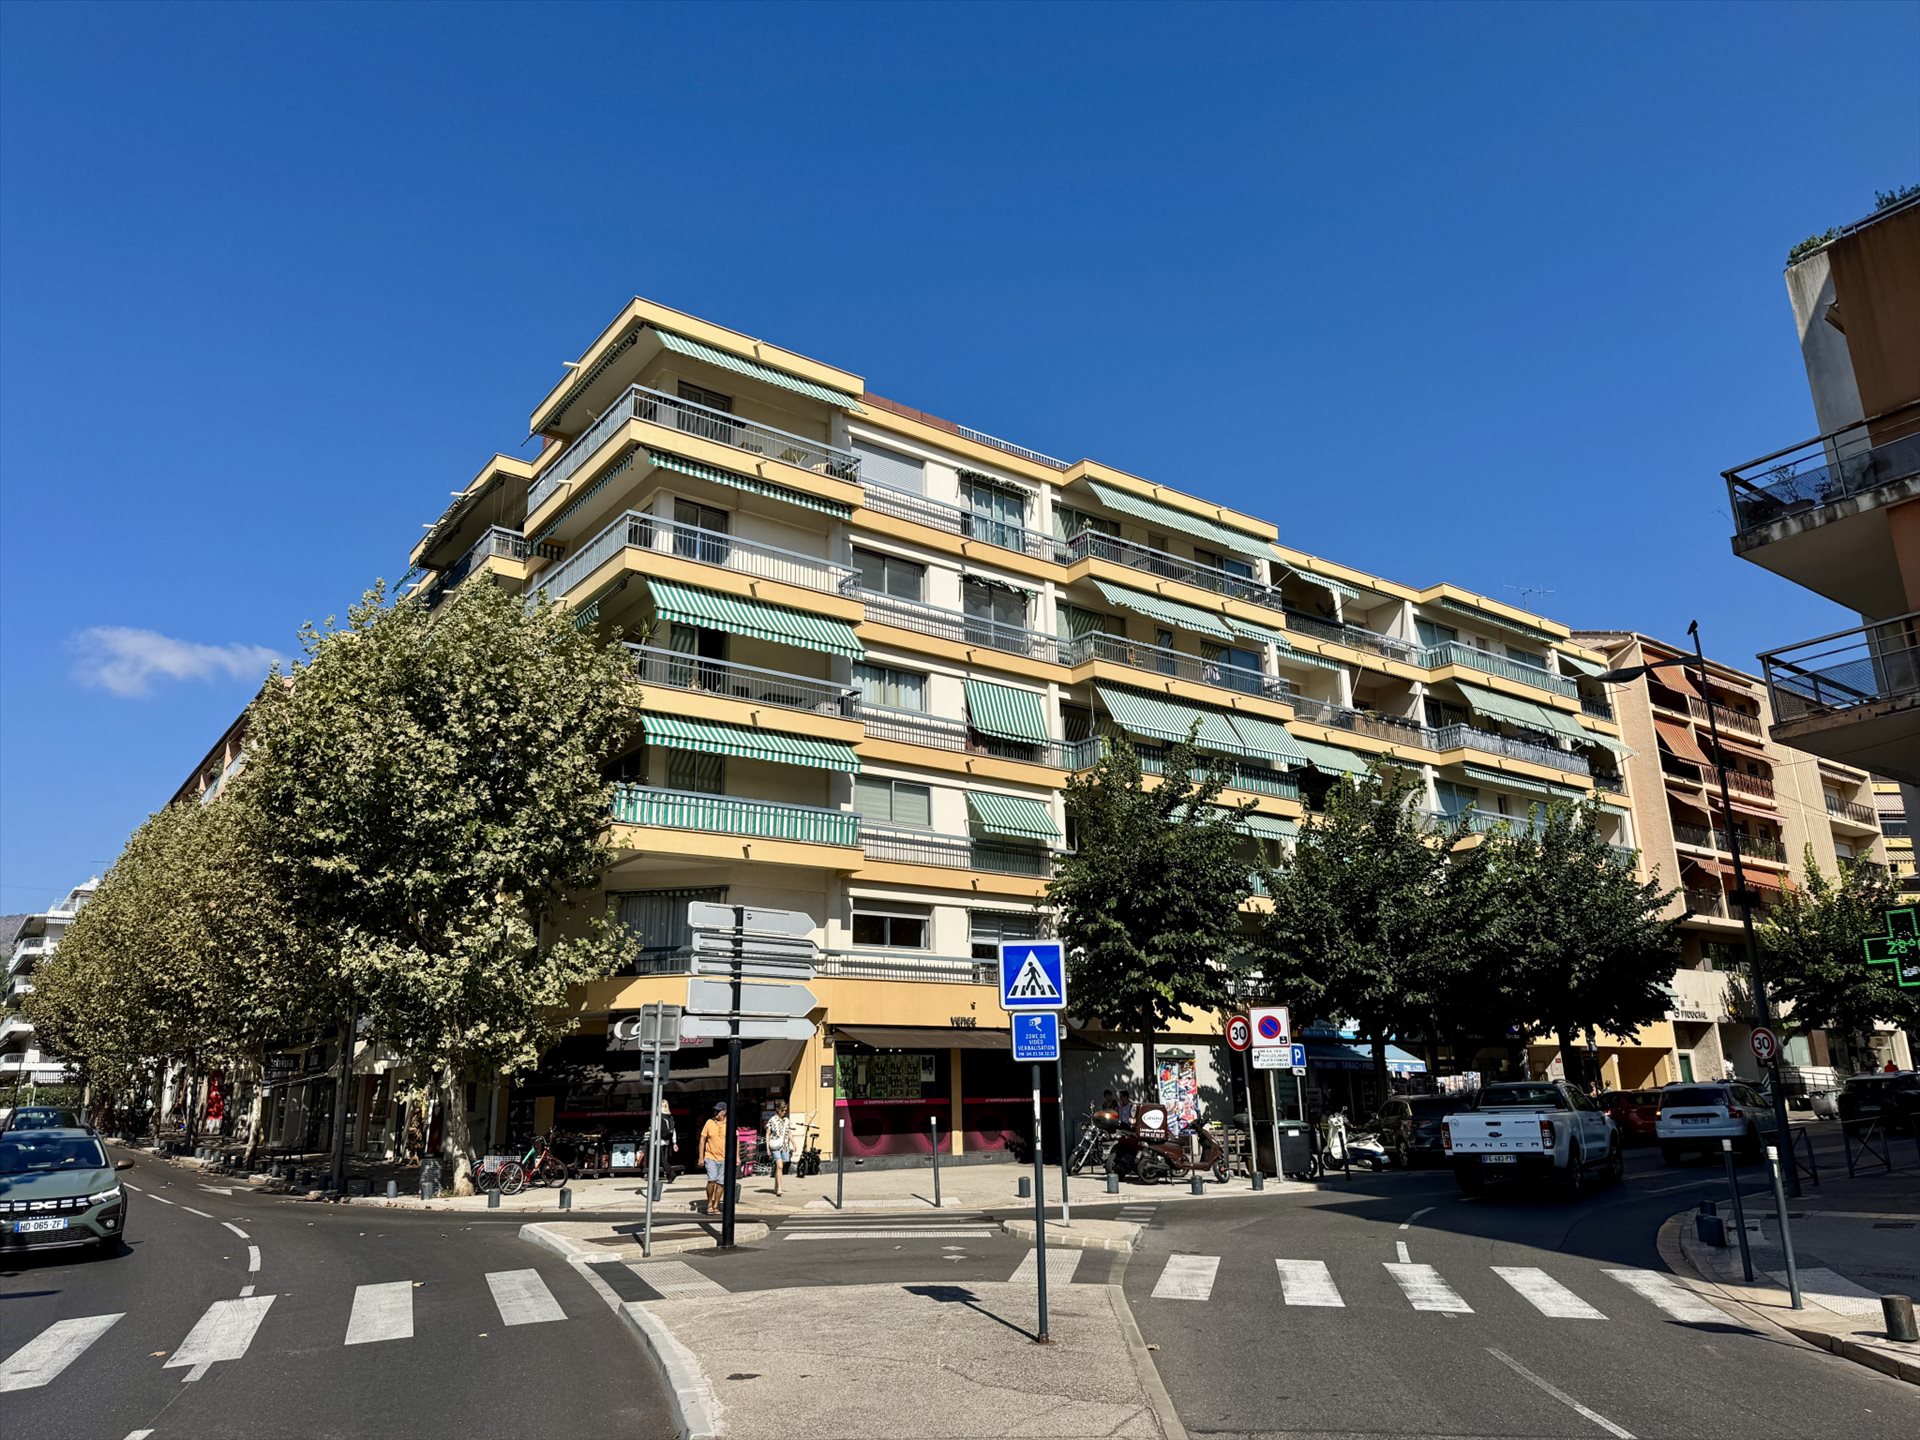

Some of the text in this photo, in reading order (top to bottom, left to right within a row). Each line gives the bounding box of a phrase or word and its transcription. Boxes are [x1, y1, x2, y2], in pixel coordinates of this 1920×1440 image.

[1232, 1026, 1247, 1041] 30
[1754, 1036, 1770, 1050] 30
[1294, 1048, 1302, 1065] P
